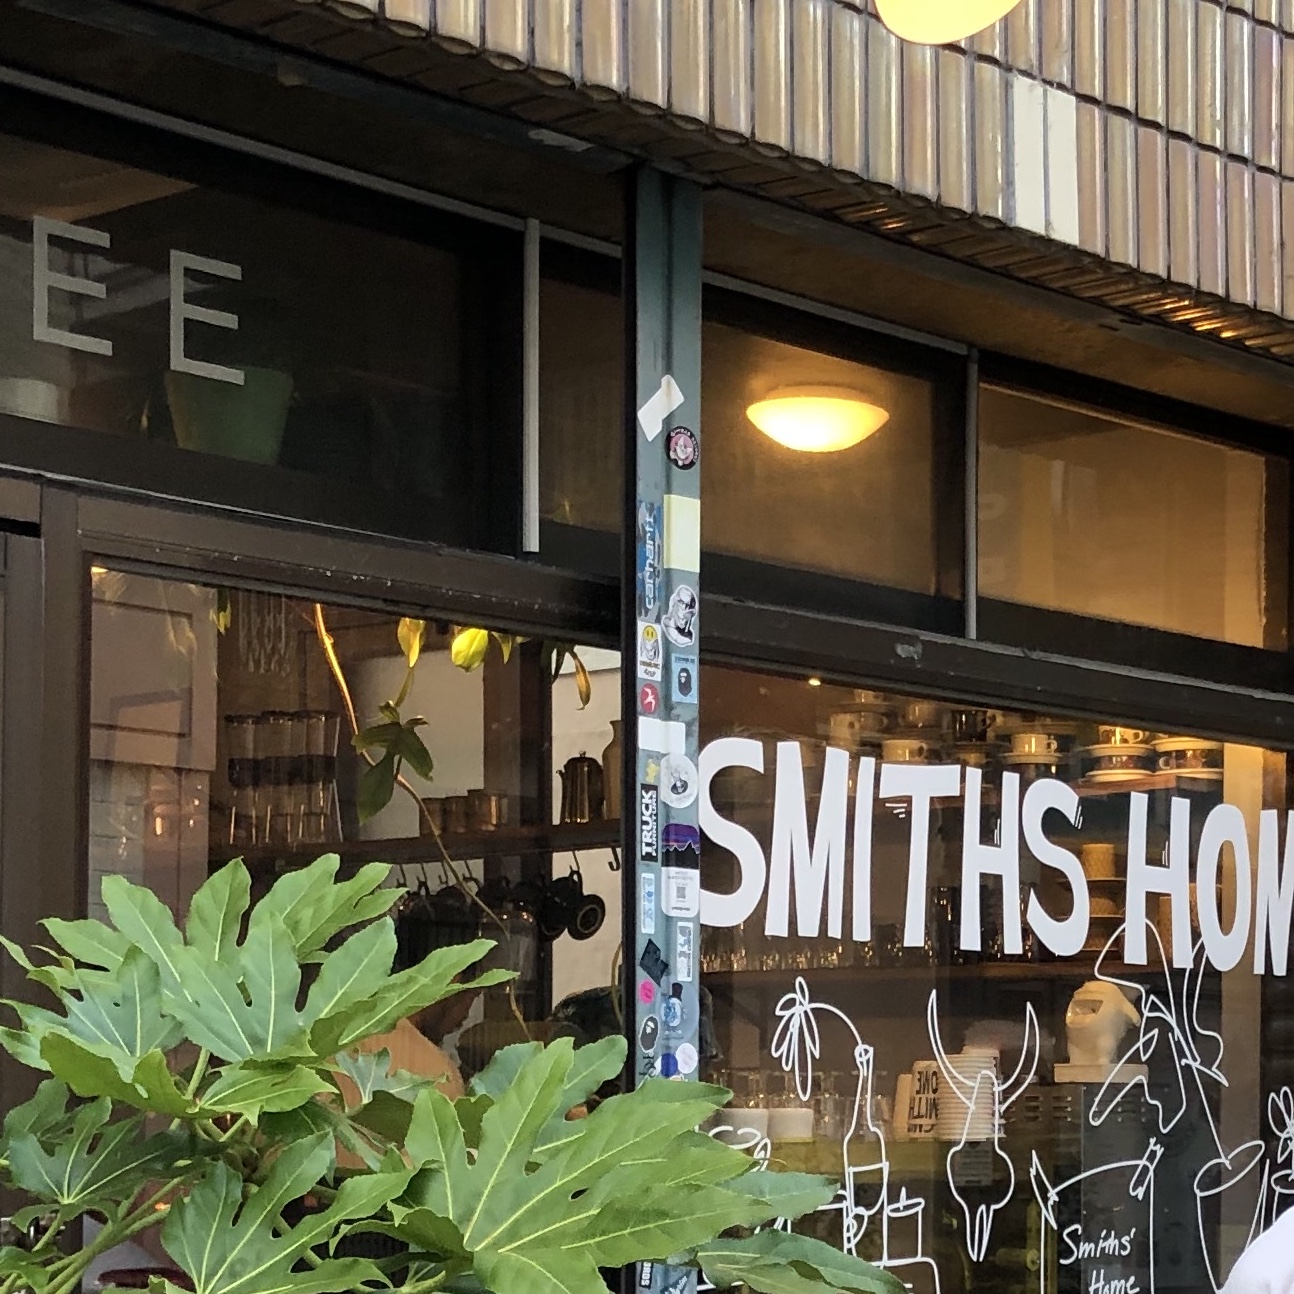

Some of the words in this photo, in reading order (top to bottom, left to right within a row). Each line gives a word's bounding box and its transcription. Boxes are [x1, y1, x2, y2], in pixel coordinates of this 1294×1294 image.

[641, 788, 653, 858] TRUCK
[698, 737, 1090, 957] SMITHS
[1059, 1223, 1136, 1265] Smiths'
